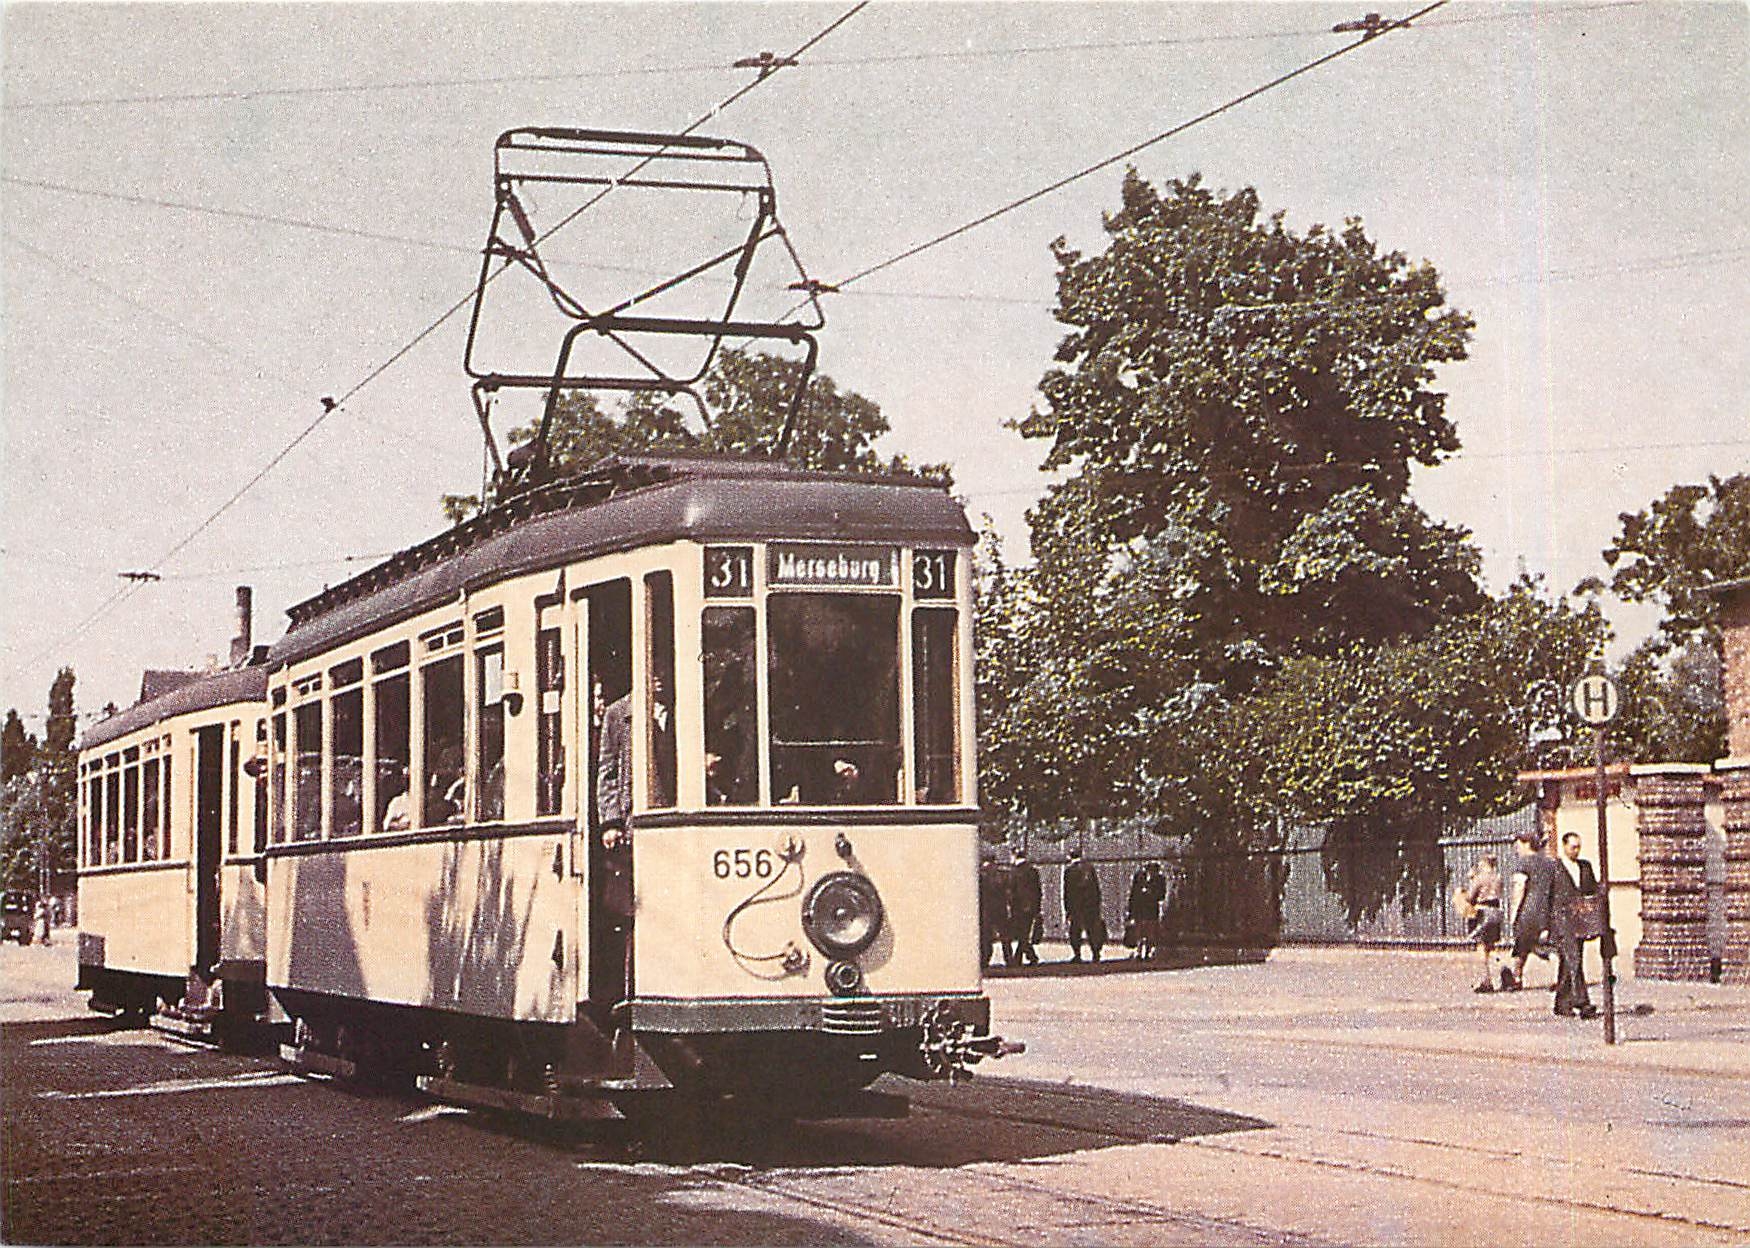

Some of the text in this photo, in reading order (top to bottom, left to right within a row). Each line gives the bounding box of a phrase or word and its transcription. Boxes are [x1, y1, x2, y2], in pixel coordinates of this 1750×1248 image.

[711, 552, 747, 587] 31
[778, 553, 880, 584] Merseburg
[914, 555, 945, 590] 31
[1583, 682, 1608, 717] H
[714, 849, 772, 879] 656
